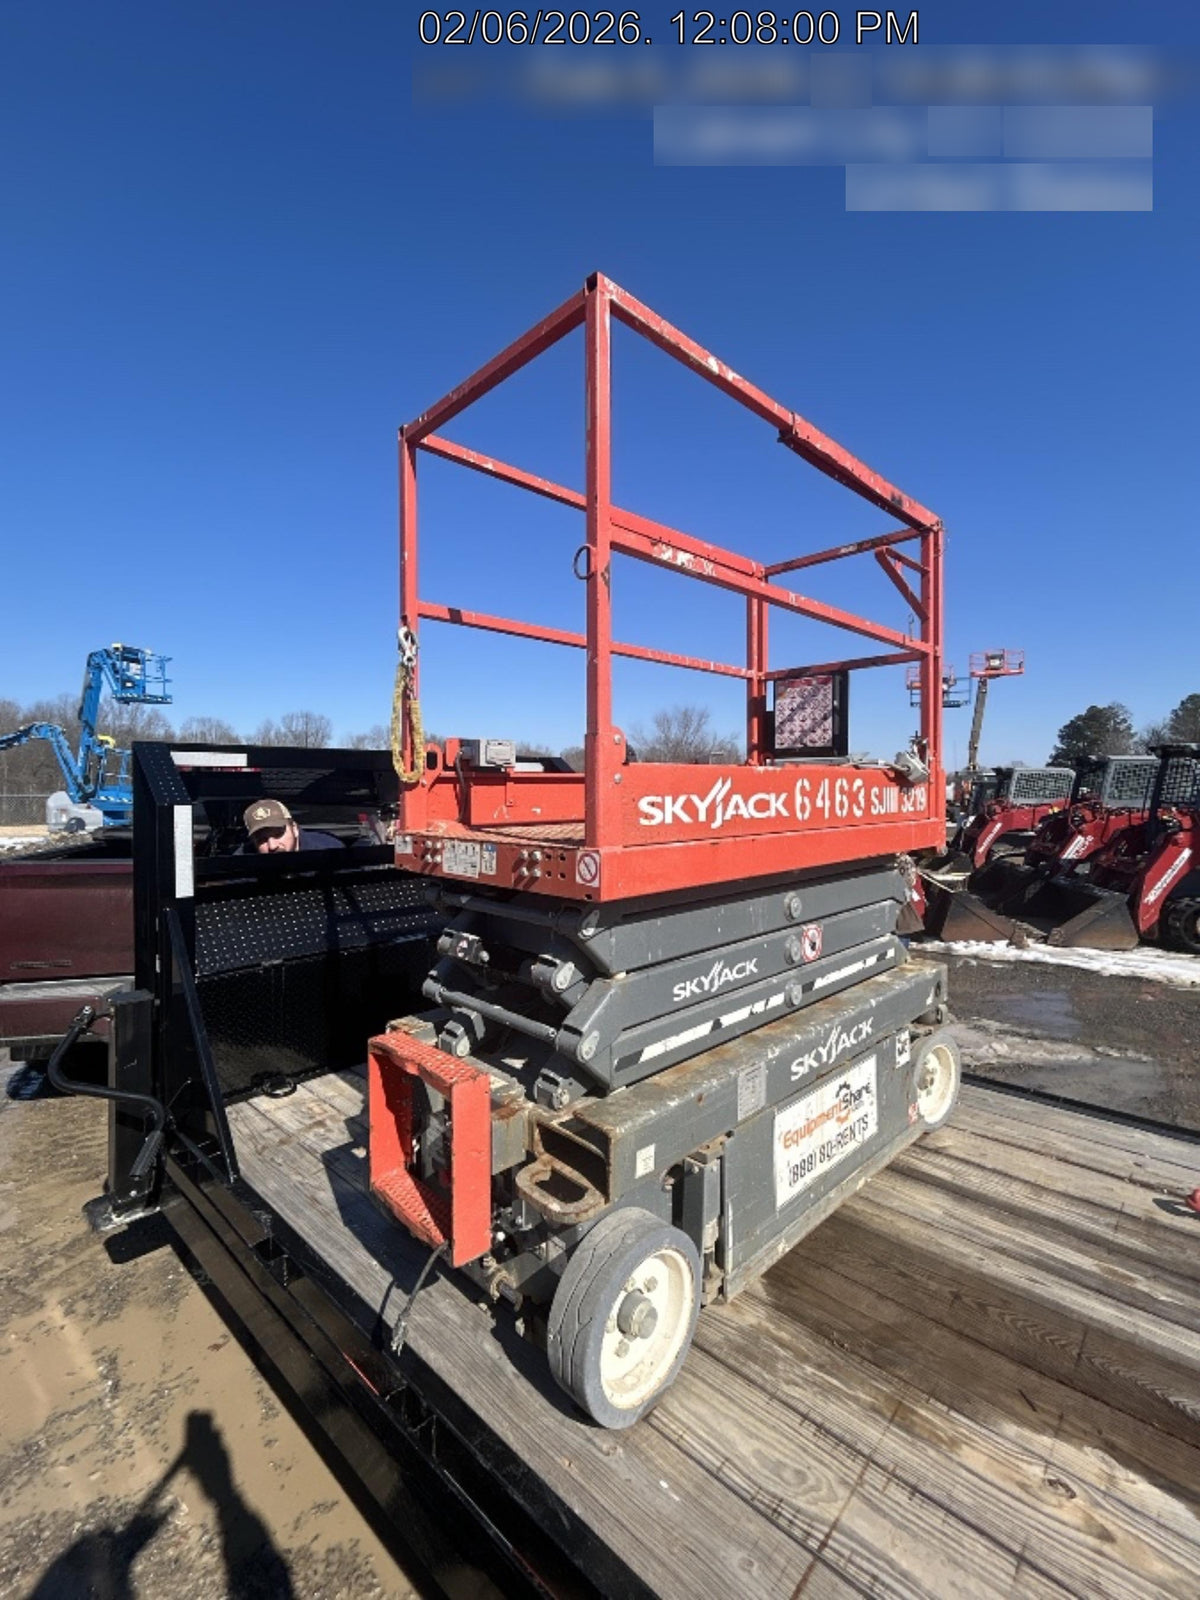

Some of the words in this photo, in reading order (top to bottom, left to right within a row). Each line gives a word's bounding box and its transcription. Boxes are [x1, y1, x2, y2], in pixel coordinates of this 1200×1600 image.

[637, 776, 790, 829] SKYJACK
[795, 778, 865, 820] 6463
[673, 958, 758, 1001] SKYJACK
[790, 1017, 874, 1081] SKYJACK
